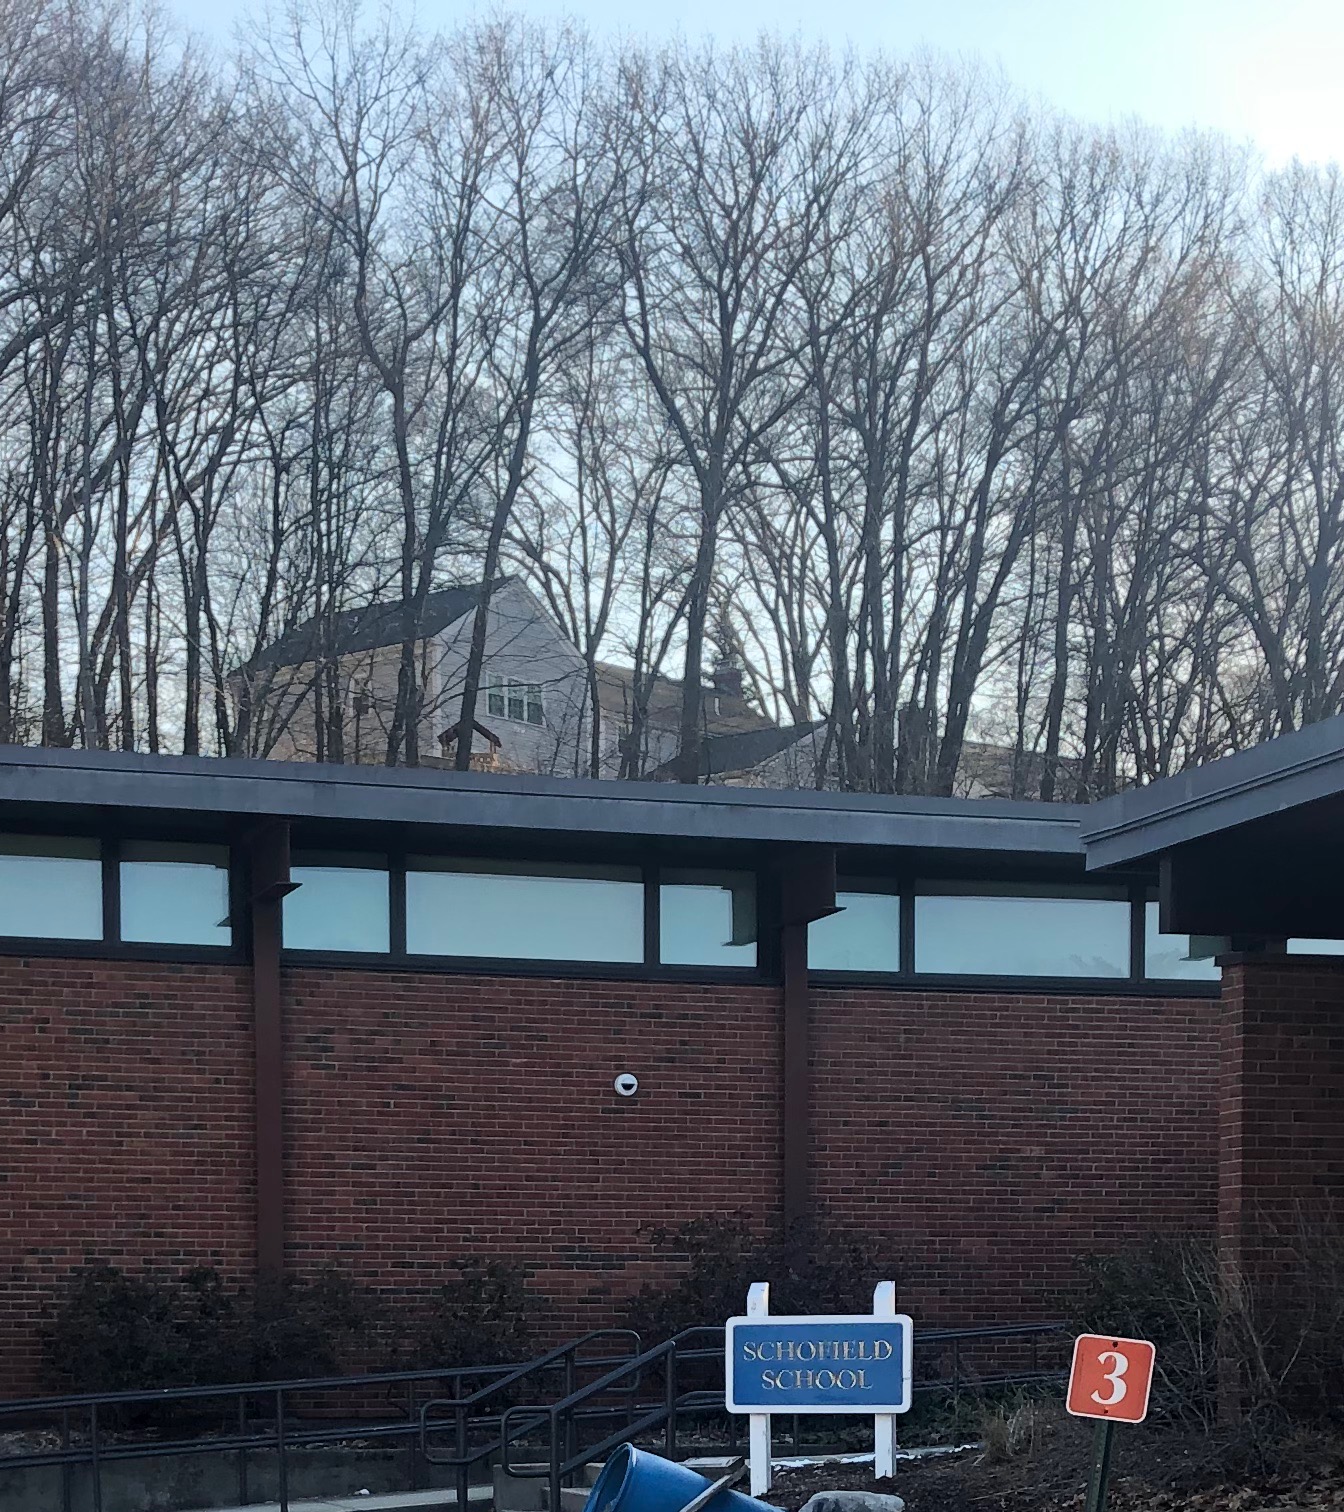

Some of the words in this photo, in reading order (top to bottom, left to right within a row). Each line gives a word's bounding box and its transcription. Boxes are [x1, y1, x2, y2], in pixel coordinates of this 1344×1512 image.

[742, 1339, 894, 1362] SCHOFIELD
[761, 1369, 874, 1390] SCHOOL
[1090, 1351, 1129, 1405] 3
